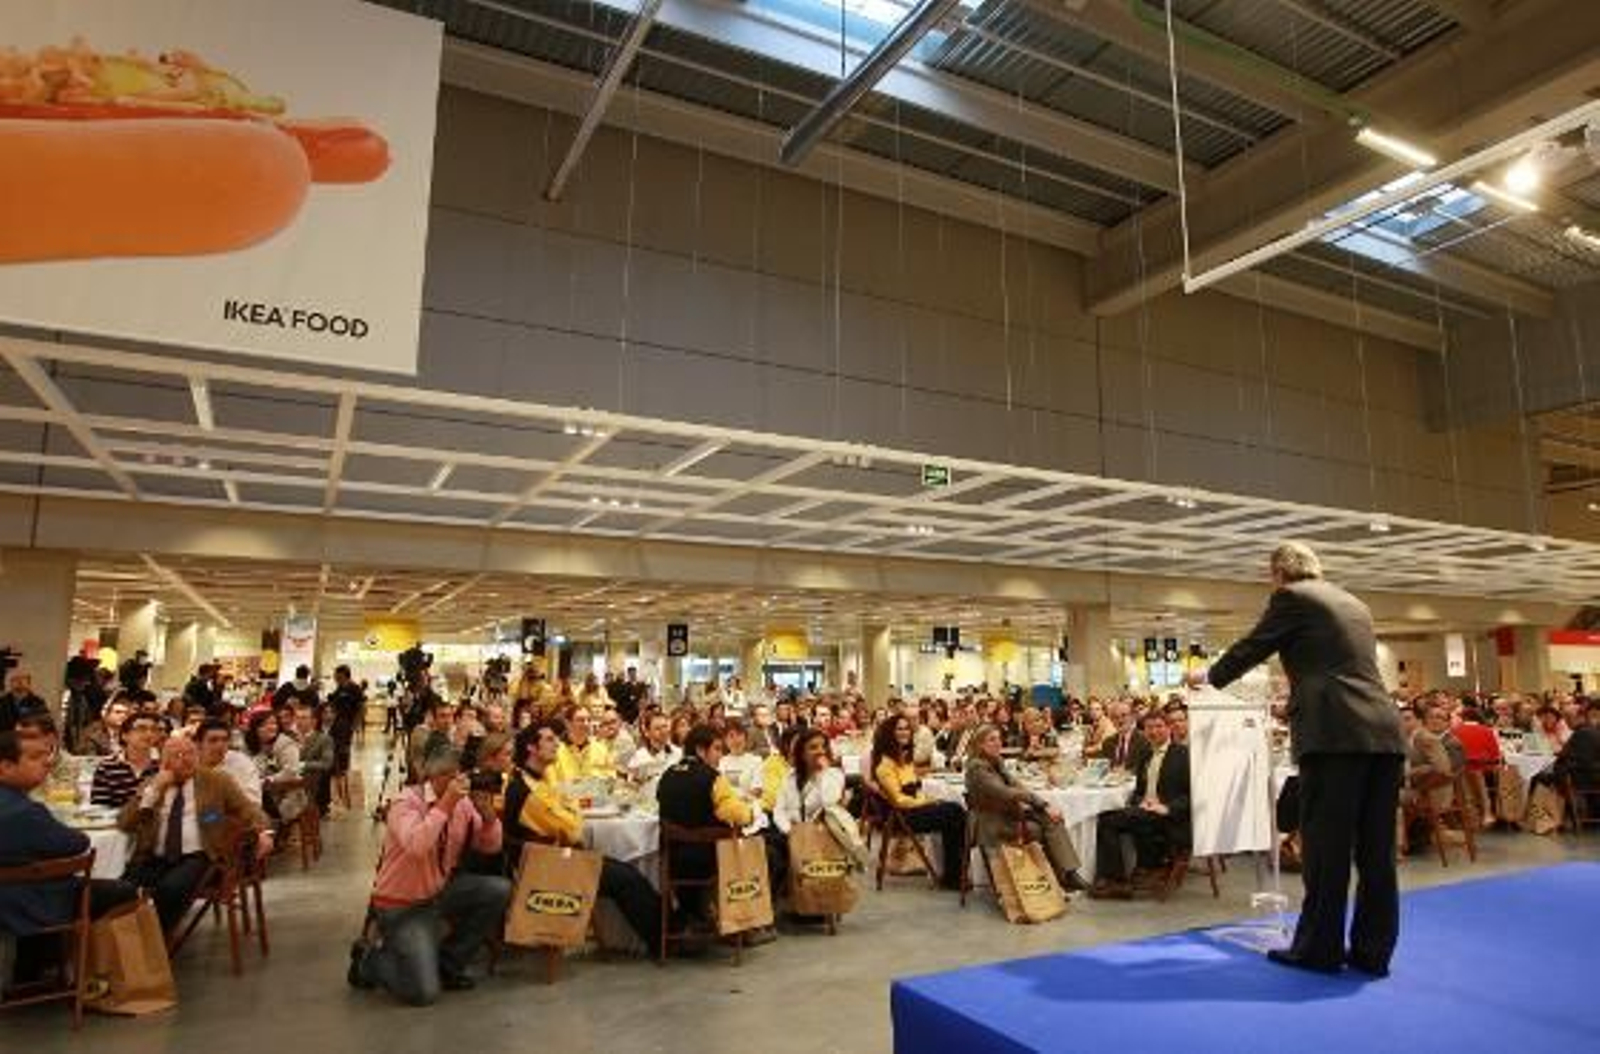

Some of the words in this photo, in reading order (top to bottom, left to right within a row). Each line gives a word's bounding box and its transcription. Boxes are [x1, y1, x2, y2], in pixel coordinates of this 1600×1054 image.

[224, 300, 286, 328] IKEA
[291, 310, 369, 338] FOOD
[534, 895, 576, 910] IKEA
